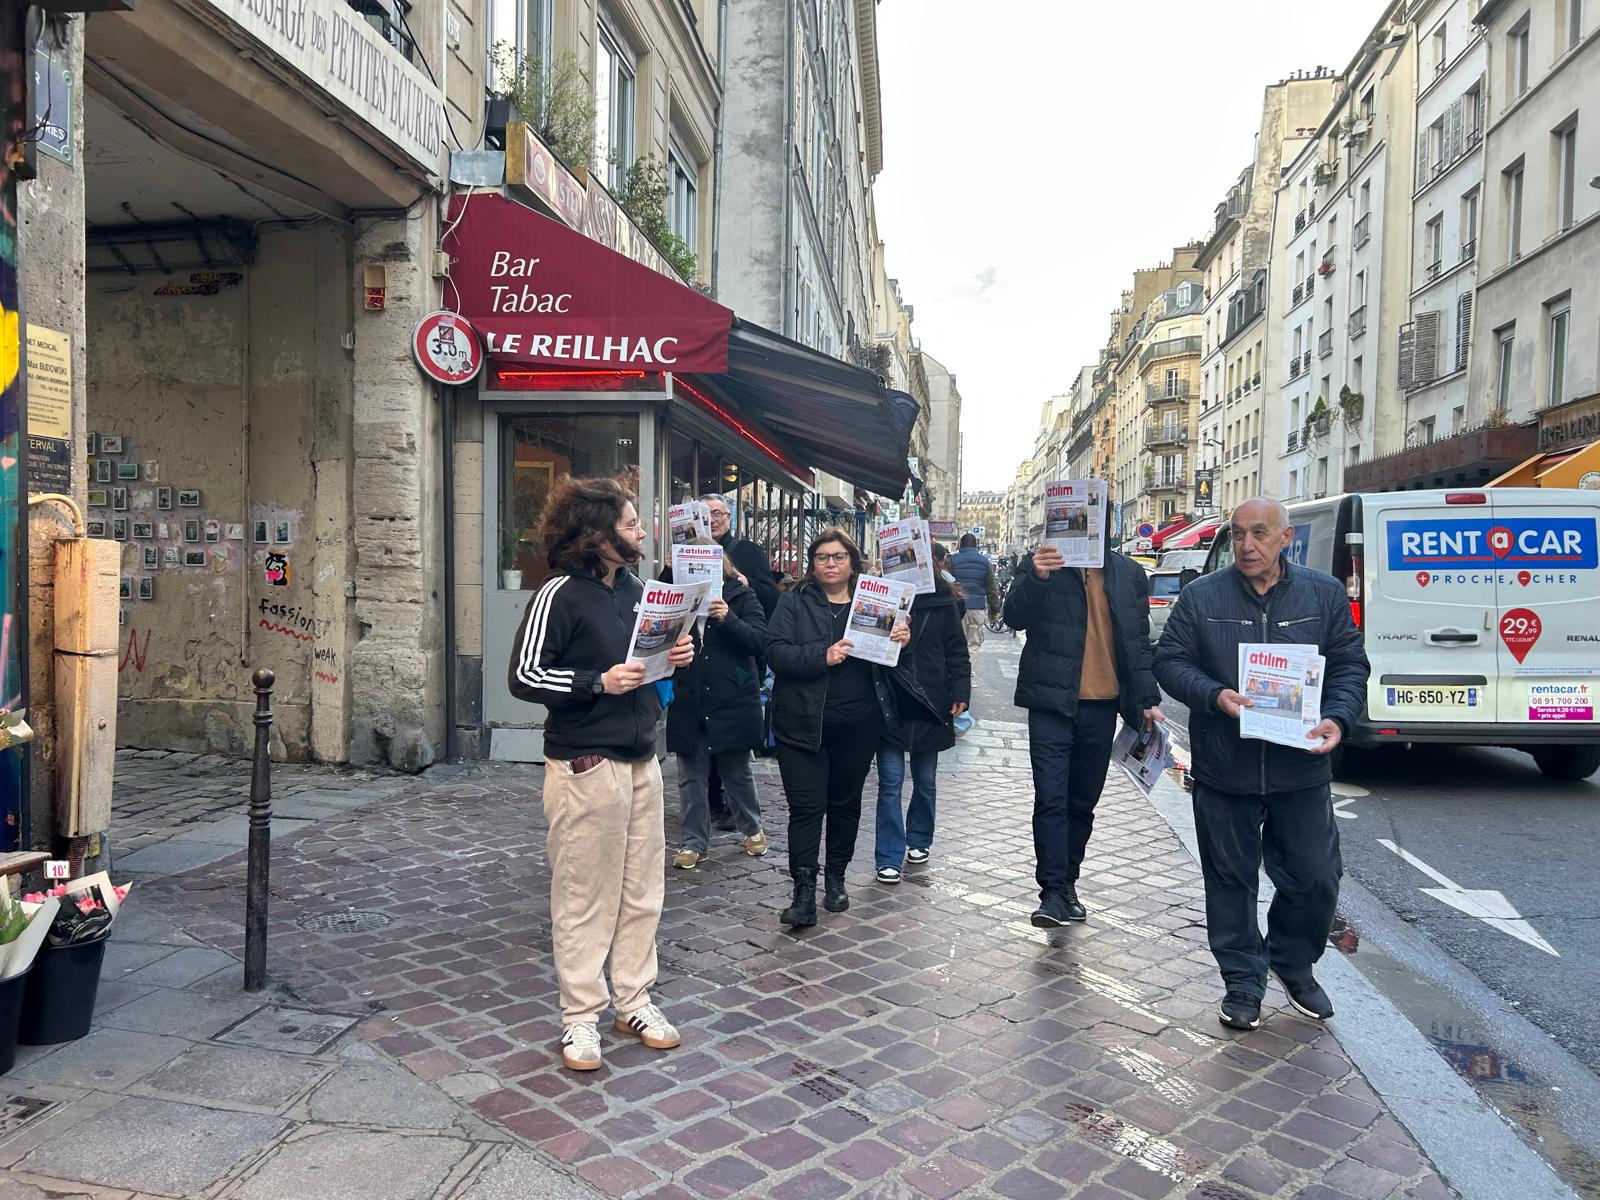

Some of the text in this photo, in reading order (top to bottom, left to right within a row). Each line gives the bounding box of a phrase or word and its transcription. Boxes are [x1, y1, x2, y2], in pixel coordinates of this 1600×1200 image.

[311, 10, 328, 56] DES
[329, 9, 388, 116] PETITES
[389, 62, 442, 159] ECURIES
[490, 250, 540, 277] Bar
[490, 284, 572, 313] Tabac
[486, 331, 679, 364] LE REILHAC
[1401, 529, 1583, 556] RENT a CAR
[1432, 574, 1577, 585] PROCHE, CHER
[1397, 690, 1466, 704] HG-650-YZ
[1531, 684, 1589, 694] rentacar.fr
[1532, 697, 1589, 705] 08 91 700 200
